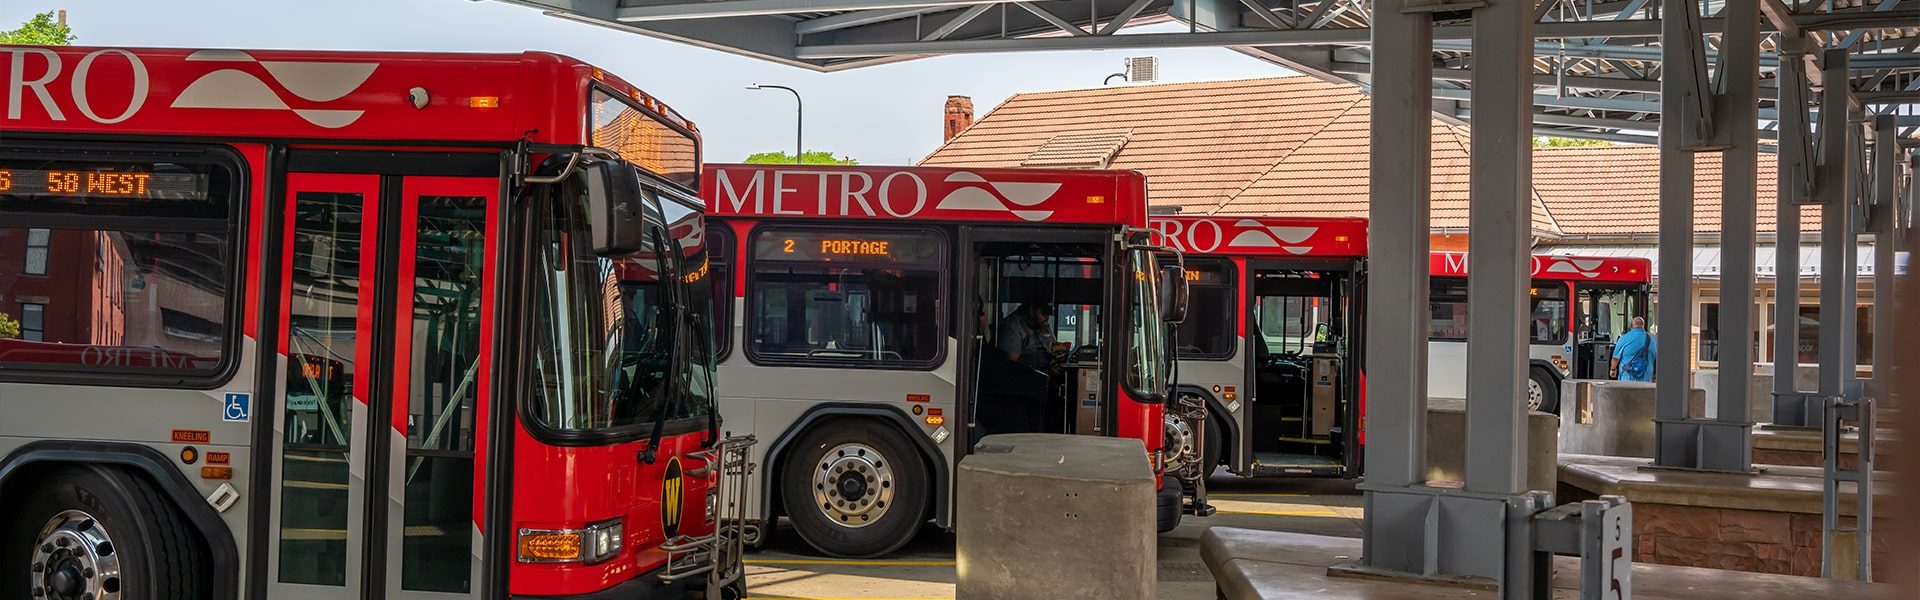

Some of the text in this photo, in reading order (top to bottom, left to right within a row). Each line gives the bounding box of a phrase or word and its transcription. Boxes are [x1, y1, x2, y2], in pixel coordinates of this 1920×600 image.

[0, 47, 150, 124] RO
[48, 172, 79, 192] 58
[87, 173, 149, 194] WEST
[714, 168, 928, 218] METRO
[784, 239, 888, 255] 2 PORTAGE
[1149, 218, 1223, 253] RO
[1065, 315, 1077, 325] 10
[174, 431, 208, 441] KNEELING
[207, 454, 228, 462] RAMP
[665, 476, 681, 527] W
[1615, 516, 1621, 541] 5
